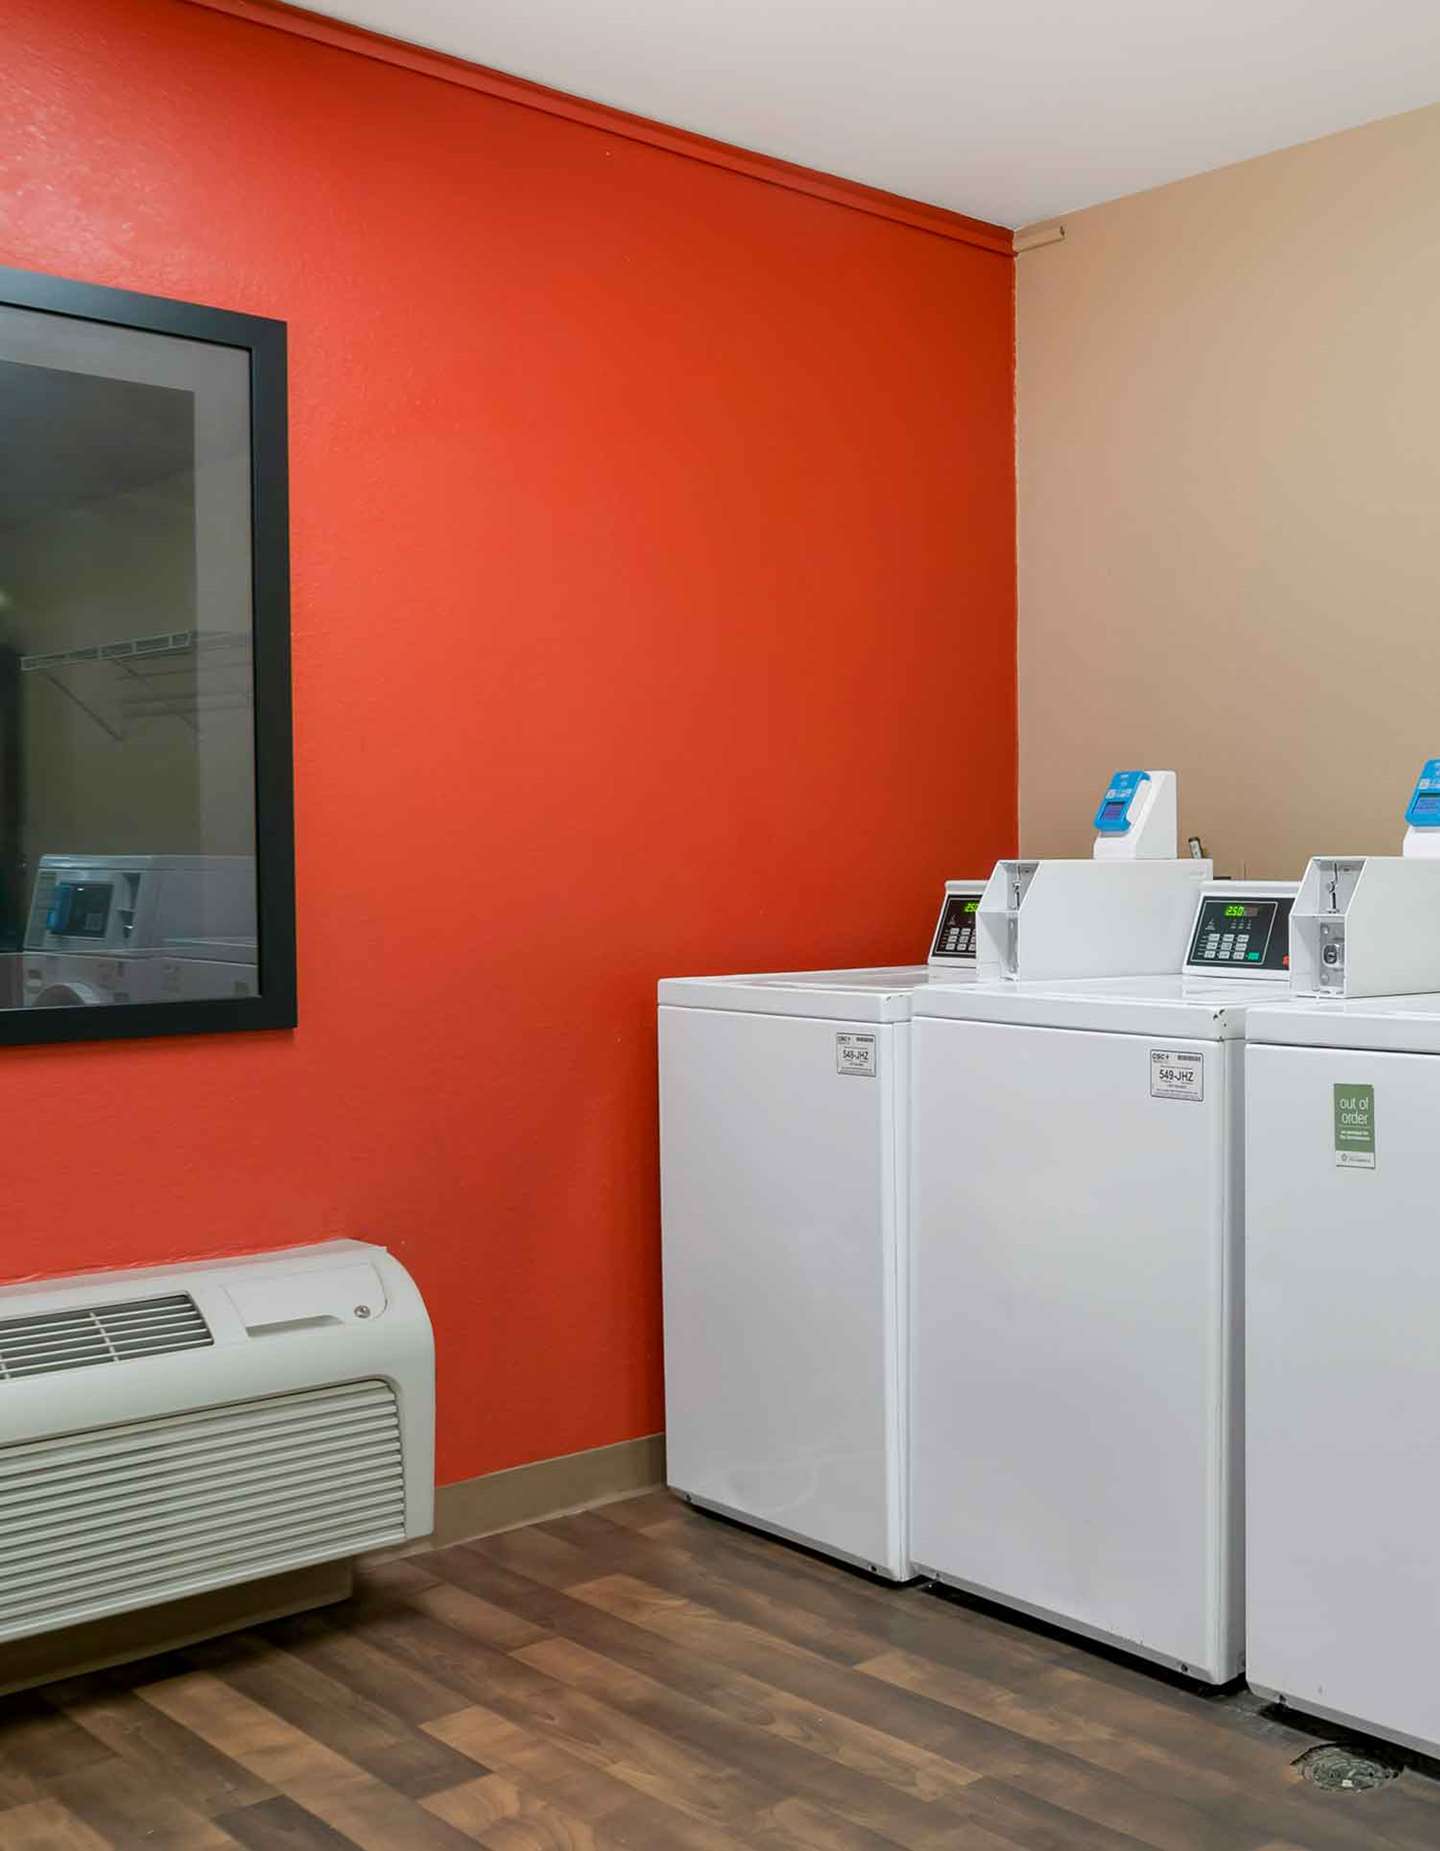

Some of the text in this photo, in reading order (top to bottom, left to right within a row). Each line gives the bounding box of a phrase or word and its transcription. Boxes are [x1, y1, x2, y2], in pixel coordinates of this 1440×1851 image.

[1159, 1069, 1194, 1082] 549-JHZ
[1340, 1098, 1356, 1110] out
[1341, 1111, 1369, 1125] order
